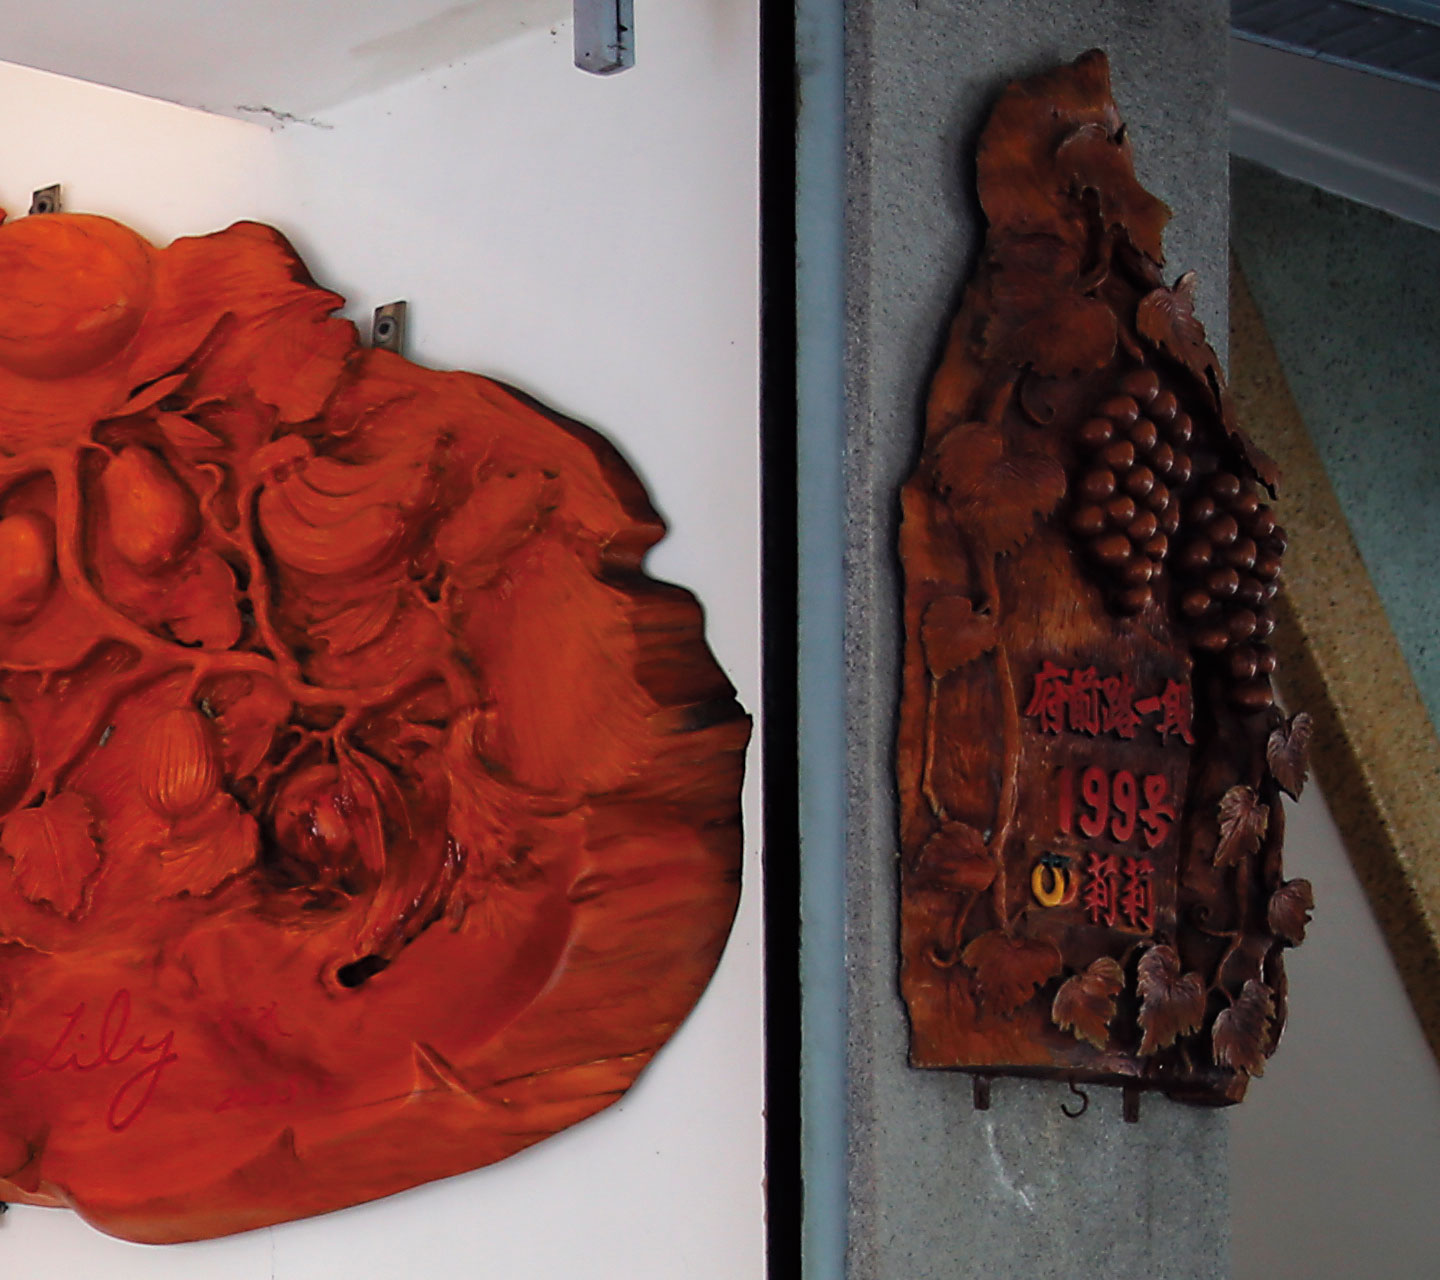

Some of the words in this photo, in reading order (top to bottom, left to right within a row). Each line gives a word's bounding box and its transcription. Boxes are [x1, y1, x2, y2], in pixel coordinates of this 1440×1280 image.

[1026, 660, 1195, 745] 府前路一段
[1084, 851, 1156, 930] 莉莉
[12, 987, 178, 1133] Lily
